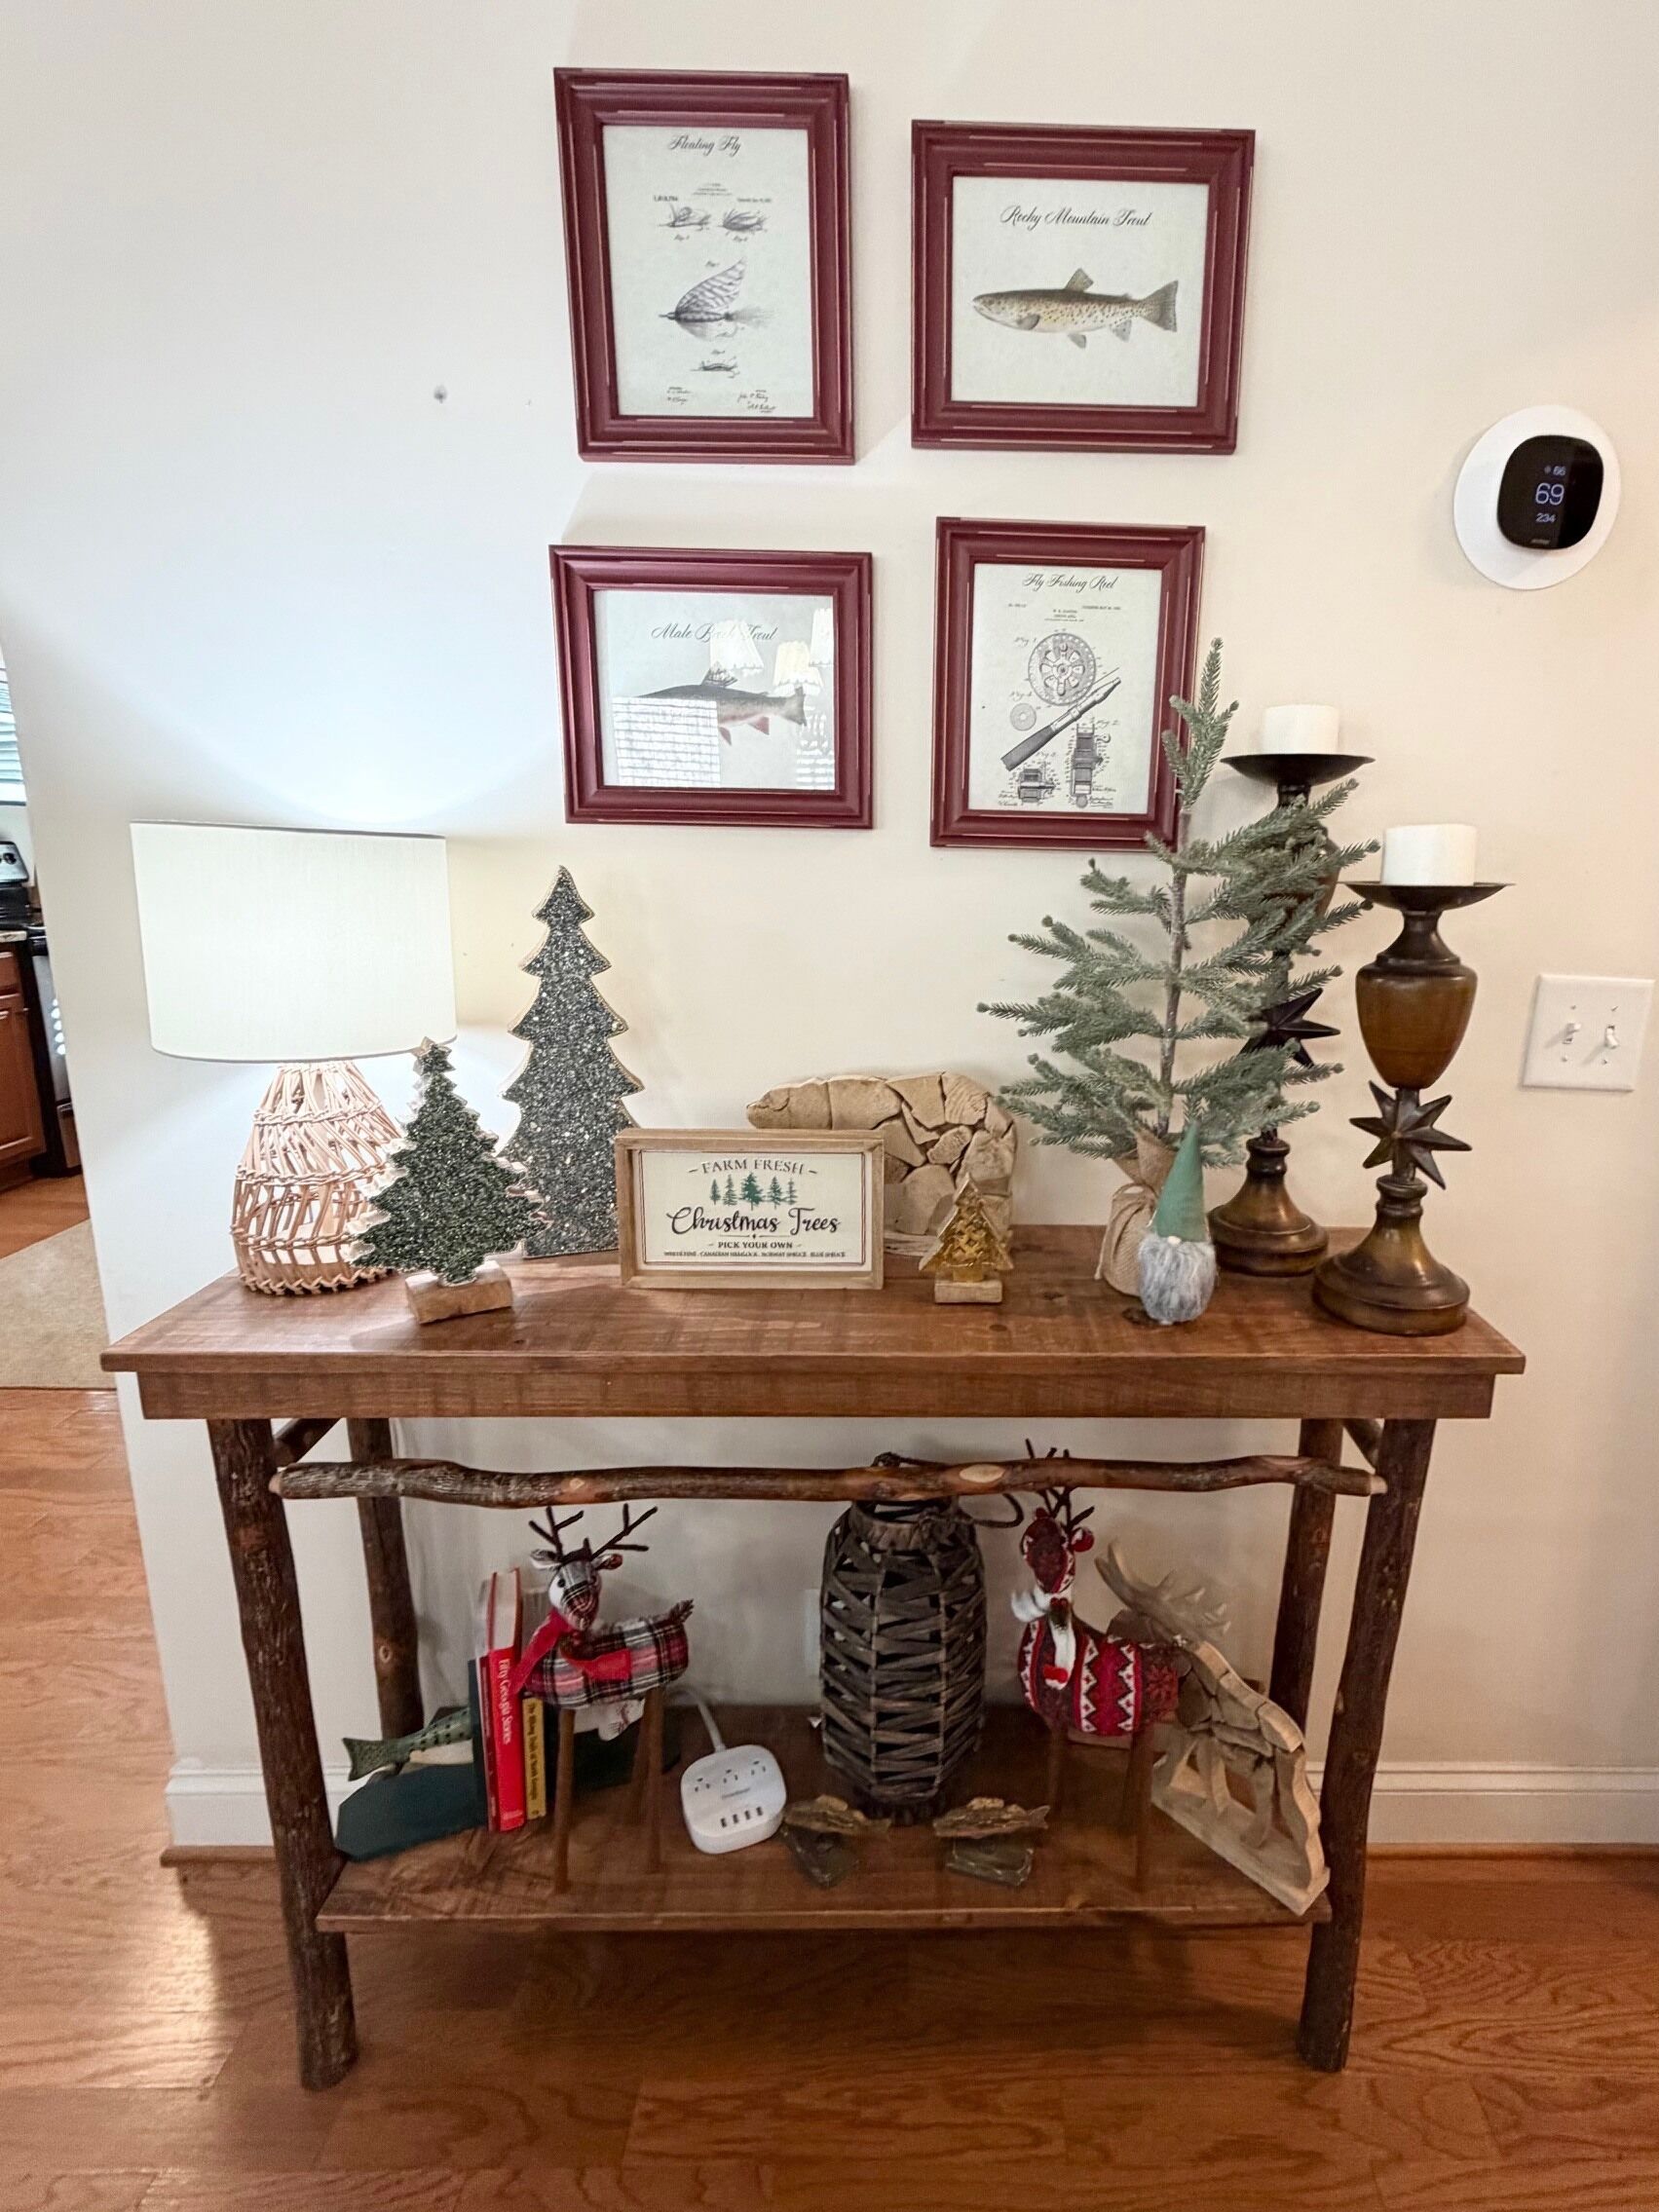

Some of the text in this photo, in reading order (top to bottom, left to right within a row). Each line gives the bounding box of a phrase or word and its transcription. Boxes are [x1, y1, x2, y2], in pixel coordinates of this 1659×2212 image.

[668, 134, 741, 157] Floating Fly
[1000, 205, 1153, 231] Rocky Mountain Trout
[1535, 482, 1565, 506] 69
[1535, 512, 1557, 523] 234
[1023, 574, 1118, 593] Fly Fishing Reel
[651, 622, 692, 640] Male
[701, 1158, 806, 1176] FARM FRESH
[666, 1206, 842, 1236] Christmas Trees
[718, 1240, 794, 1250] PICK YOUR OWN
[499, 1679, 513, 1716] Georgia
[528, 1703, 537, 1714] The
[502, 1715, 514, 1744] Stories
[528, 1714, 537, 1735] Hiking
[530, 1760, 539, 1778] North
